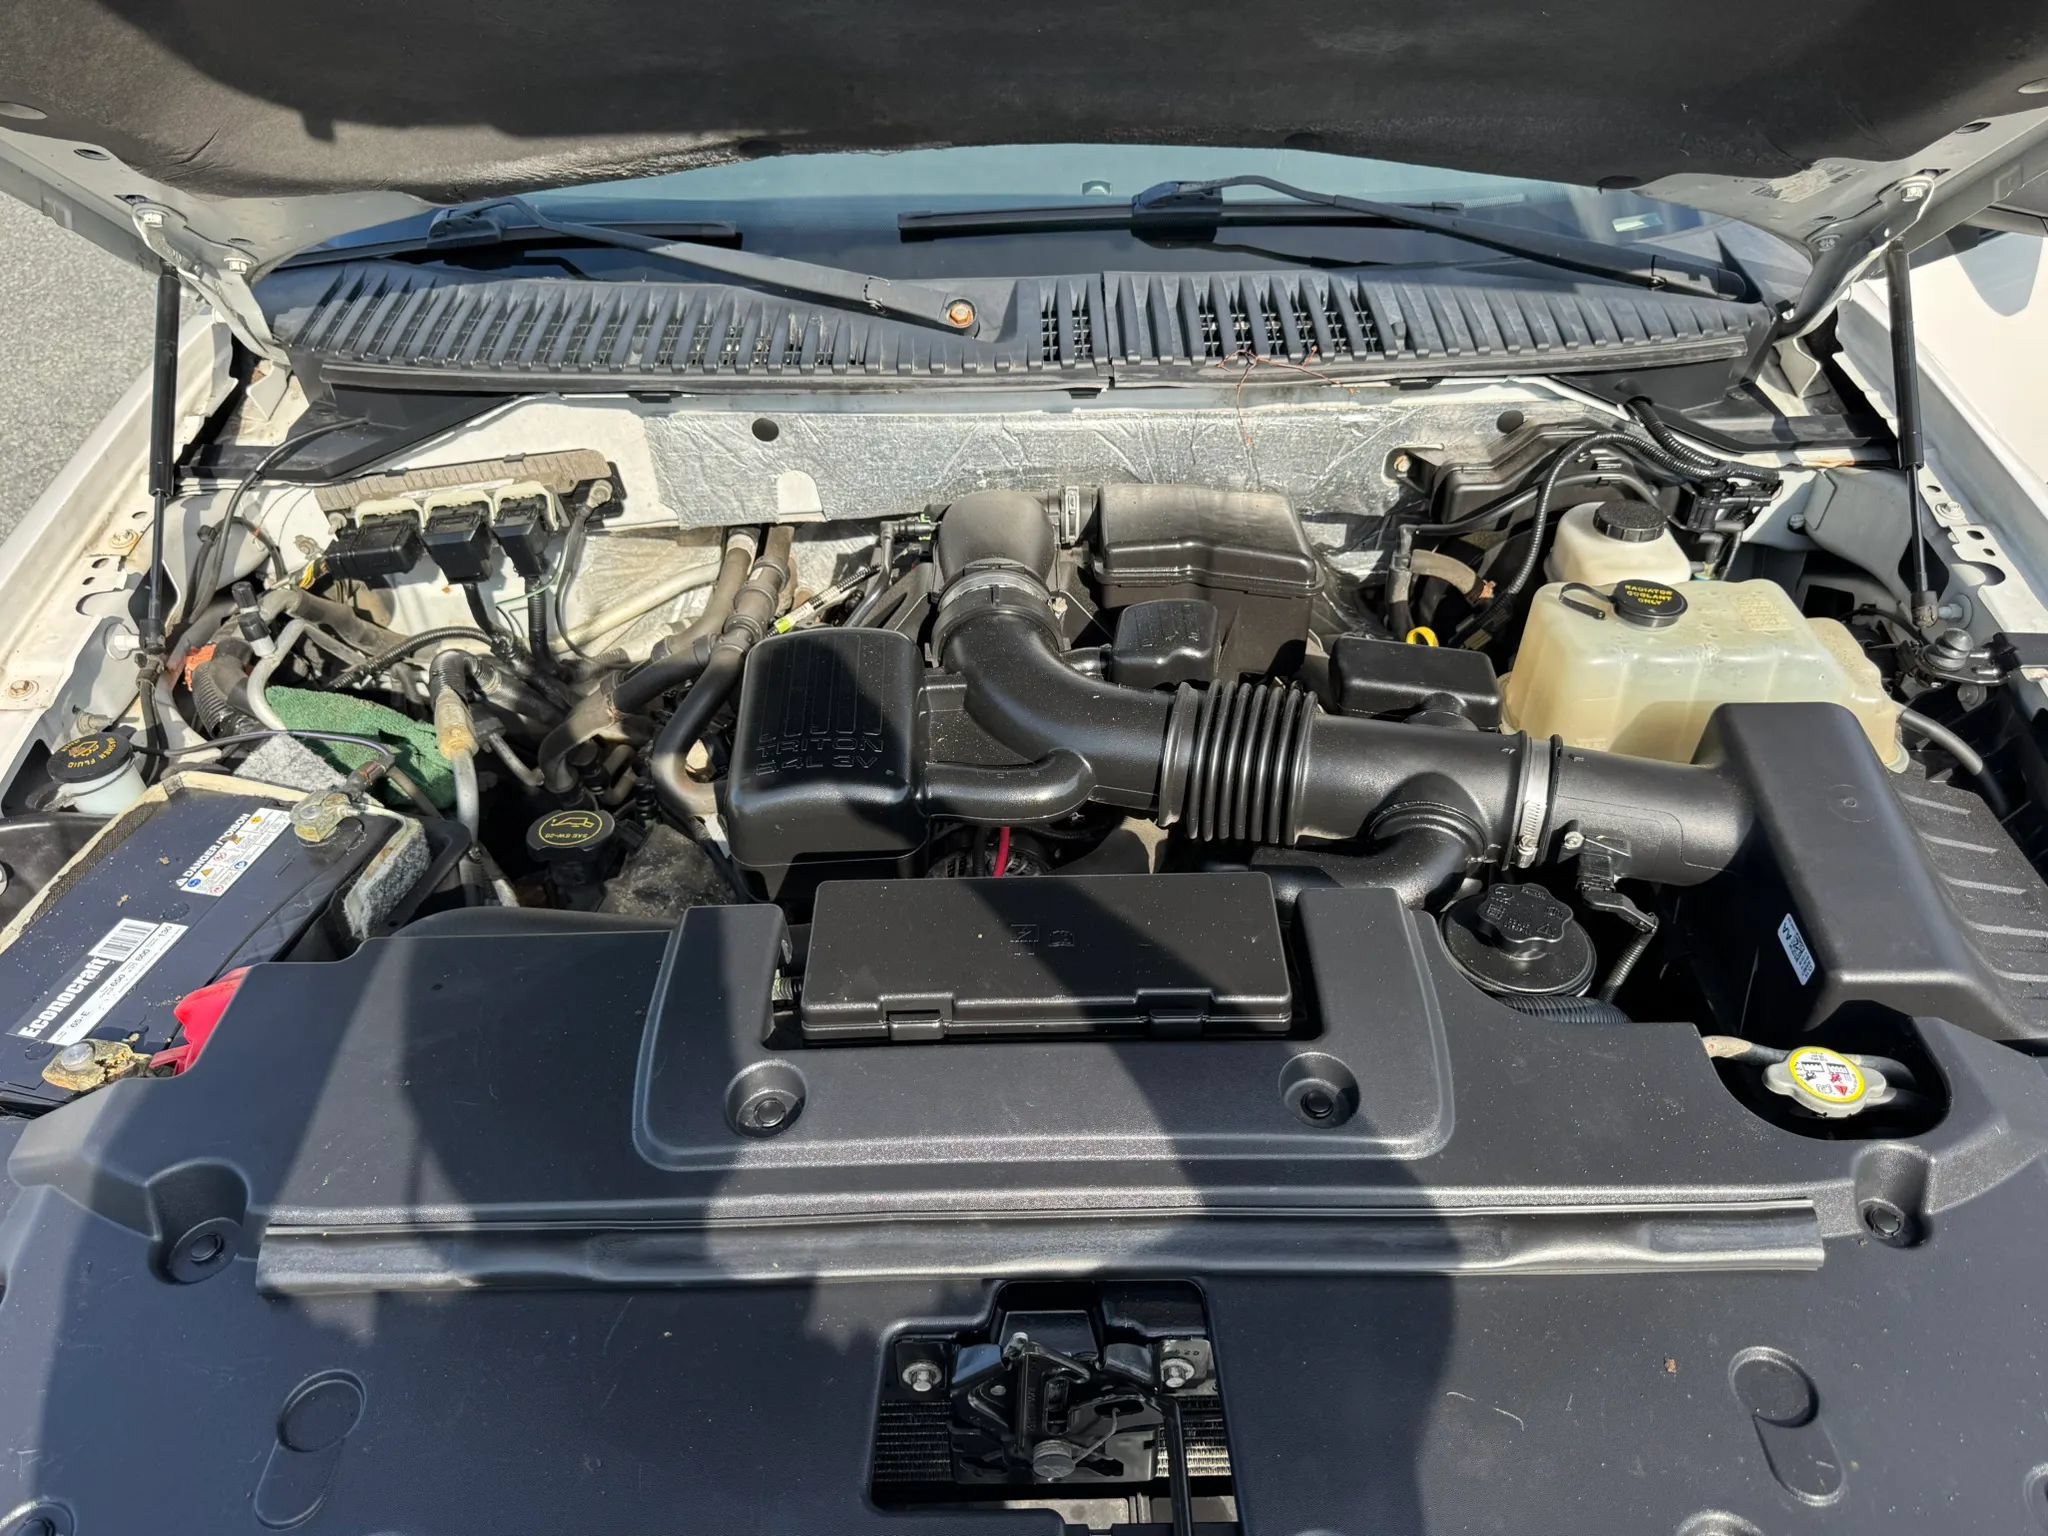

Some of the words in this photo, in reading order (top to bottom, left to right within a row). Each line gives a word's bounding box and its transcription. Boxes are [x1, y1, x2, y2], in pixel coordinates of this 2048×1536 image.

[1624, 584, 1673, 596] RADIATOR
[1626, 590, 1673, 601] COOLANT
[1637, 597, 1662, 605] ONLY
[756, 736, 884, 758] TRITON
[67, 758, 97, 769] FLUID
[754, 755, 824, 776] 5.4L
[832, 754, 879, 769] 3V
[182, 844, 220, 878] DANGER
[16, 956, 112, 1039] Econocraft
